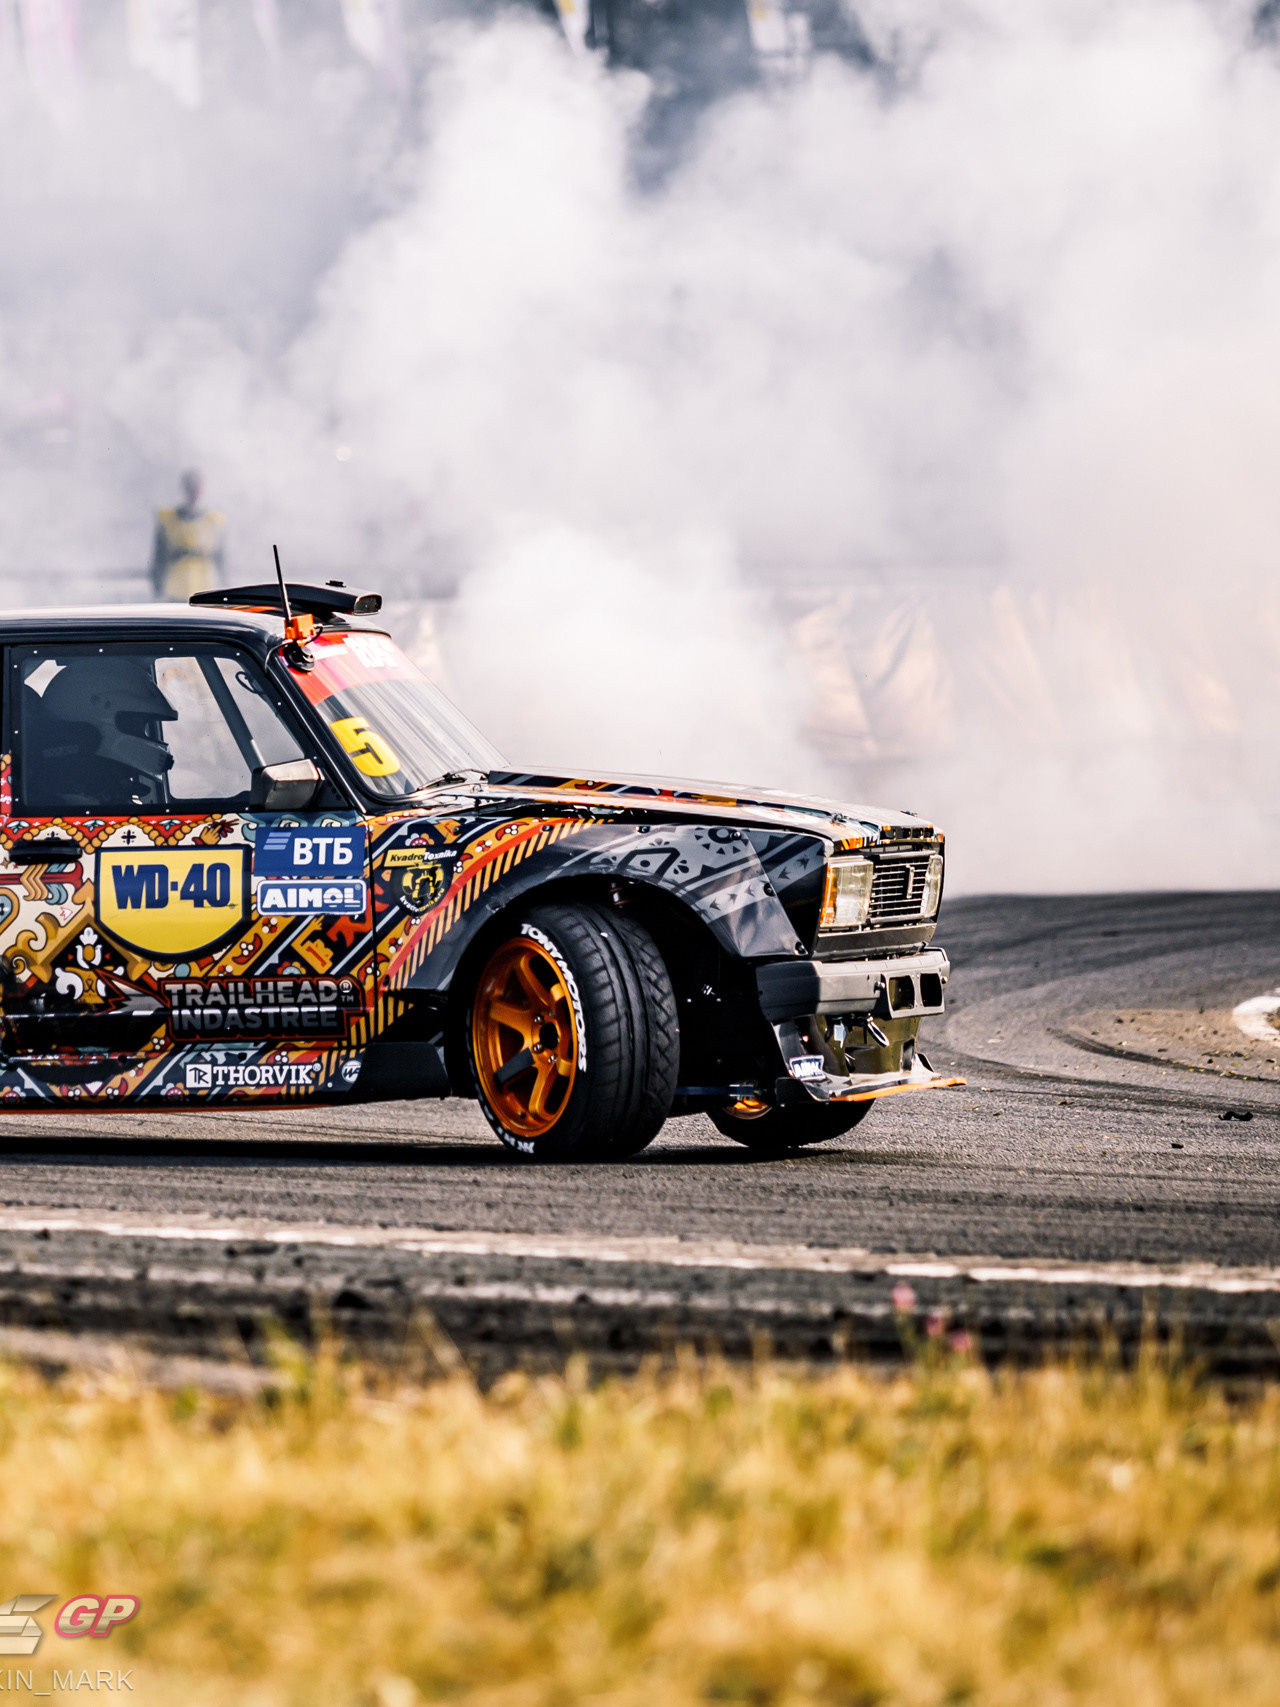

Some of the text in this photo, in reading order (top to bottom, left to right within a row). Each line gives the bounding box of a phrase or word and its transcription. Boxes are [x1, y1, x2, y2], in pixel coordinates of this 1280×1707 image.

[329, 716, 401, 777] 5
[293, 837, 353, 865] ВТБ
[111, 862, 231, 910] WD-40
[261, 887, 361, 909] AIMOL
[164, 980, 339, 1007] TRAILHEAD
[171, 1005, 338, 1031] INDASTREE
[213, 1064, 313, 1085] THORVIK
